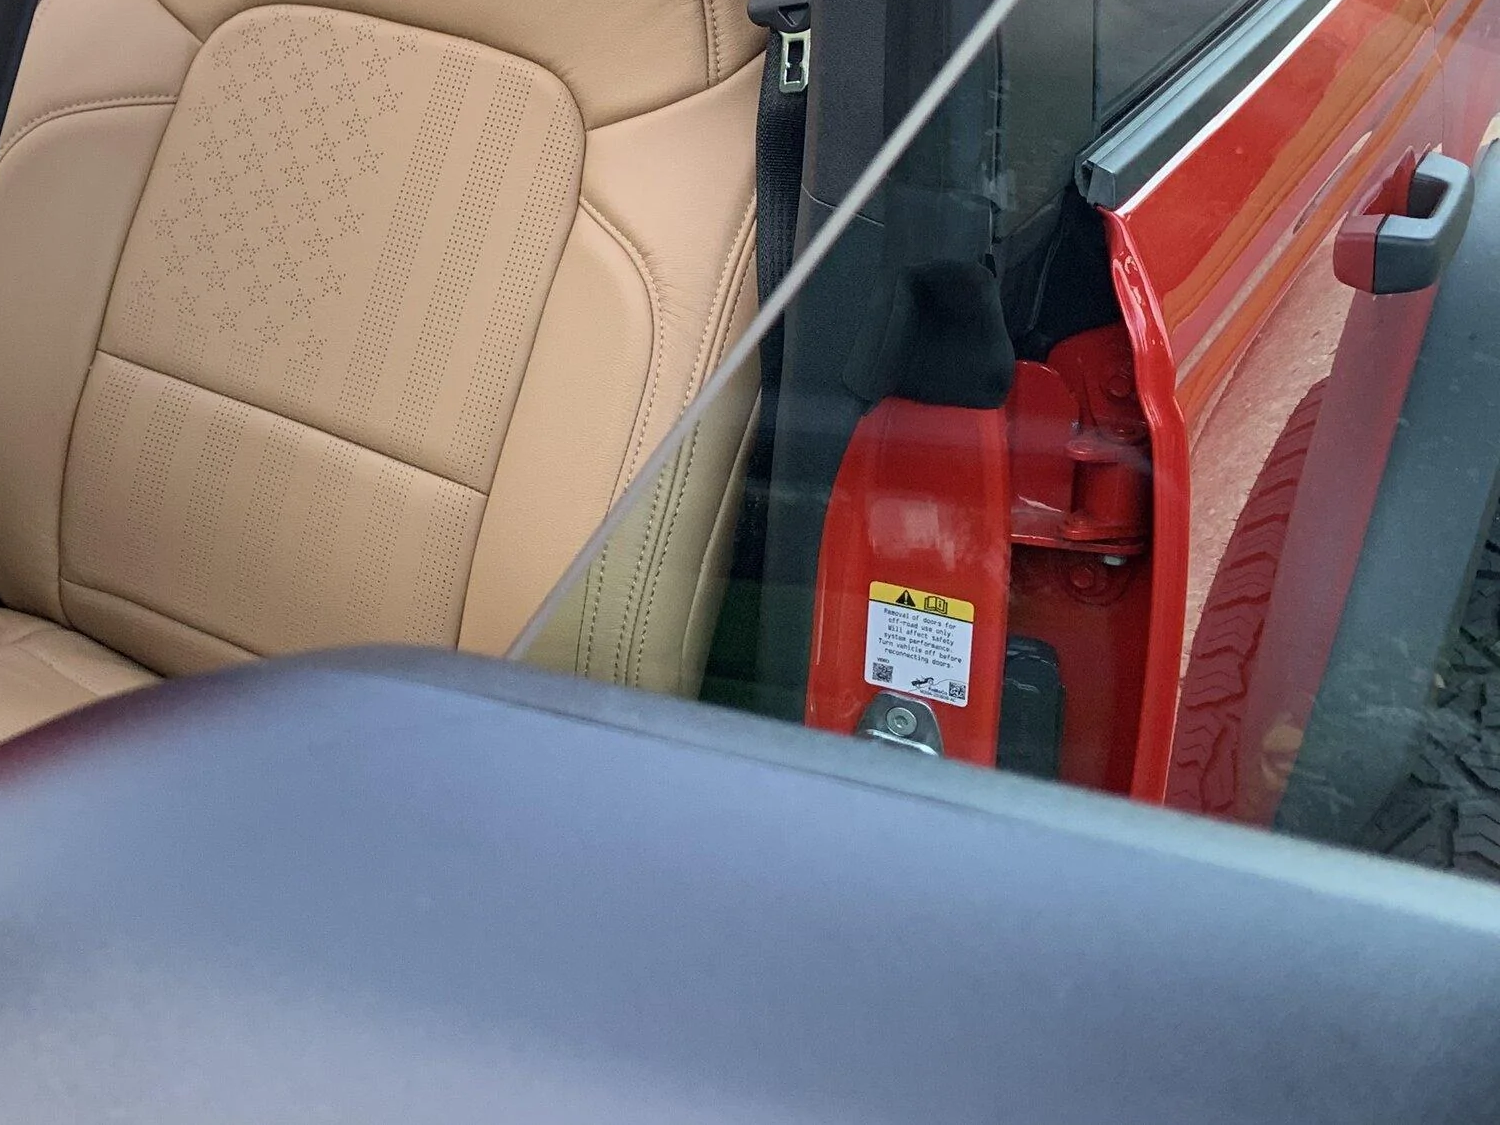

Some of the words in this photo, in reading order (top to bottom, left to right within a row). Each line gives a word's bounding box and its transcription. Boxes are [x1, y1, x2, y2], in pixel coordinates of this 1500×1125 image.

[884, 608, 909, 619] Removal
[923, 618, 942, 627] doors
[888, 618, 918, 628] off-road
[884, 632, 906, 642] system
[888, 625, 902, 633] Will
[906, 630, 928, 639] affect
[932, 636, 954, 646] safety
[879, 638, 893, 646] Turn
[897, 642, 922, 653] vehicle
[939, 653, 962, 663] before
[885, 647, 929, 663] reconnecting
